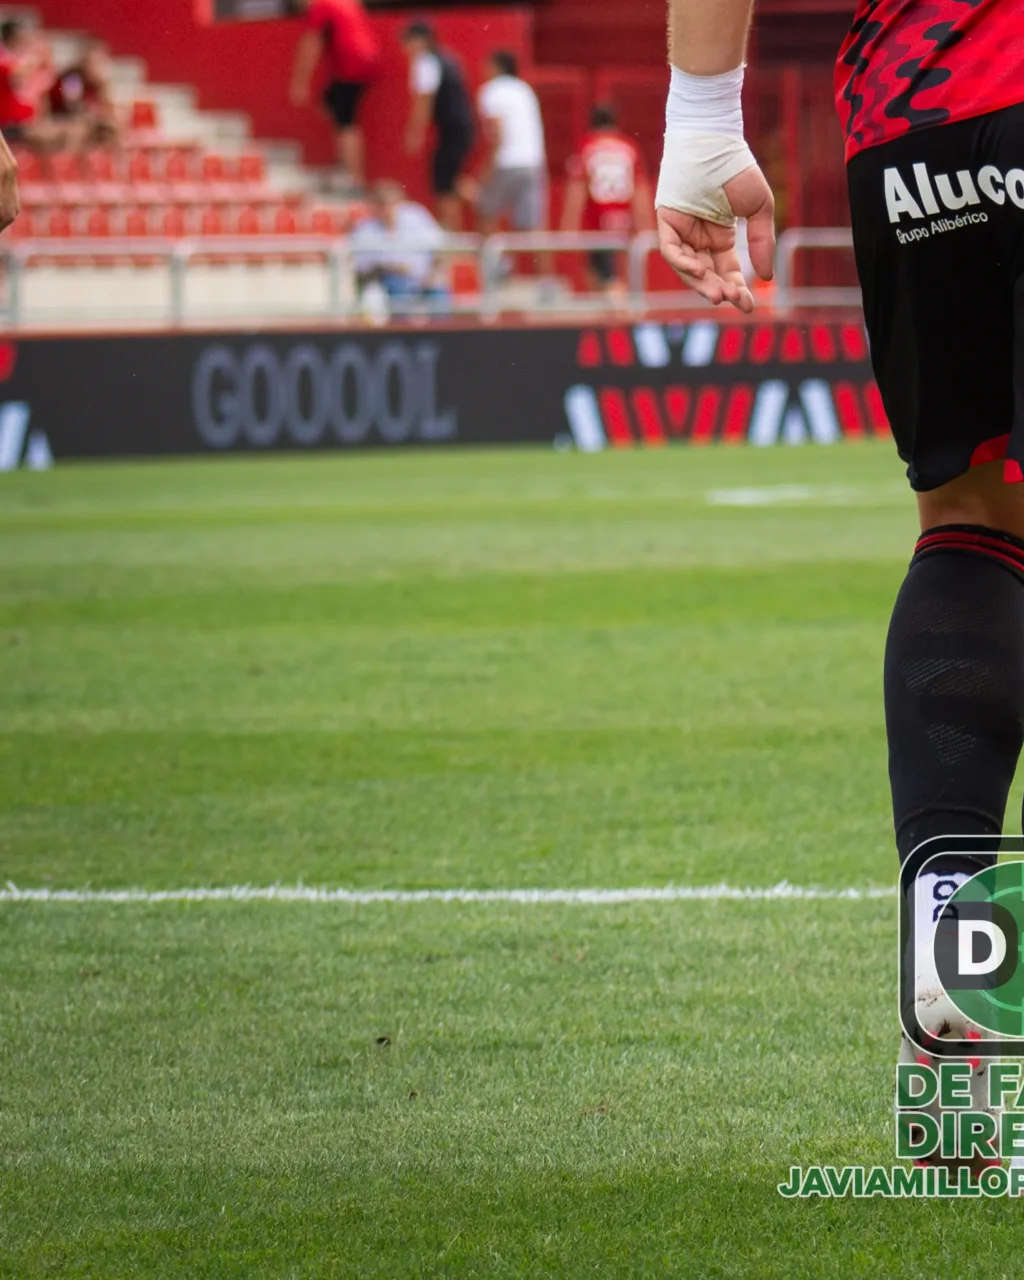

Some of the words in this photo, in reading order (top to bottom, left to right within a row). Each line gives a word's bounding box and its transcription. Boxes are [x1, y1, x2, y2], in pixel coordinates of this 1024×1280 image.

[896, 228, 930, 244] Grupo
[931, 212, 988, 235] Alibérico
[194, 343, 456, 447] GOOOOL
